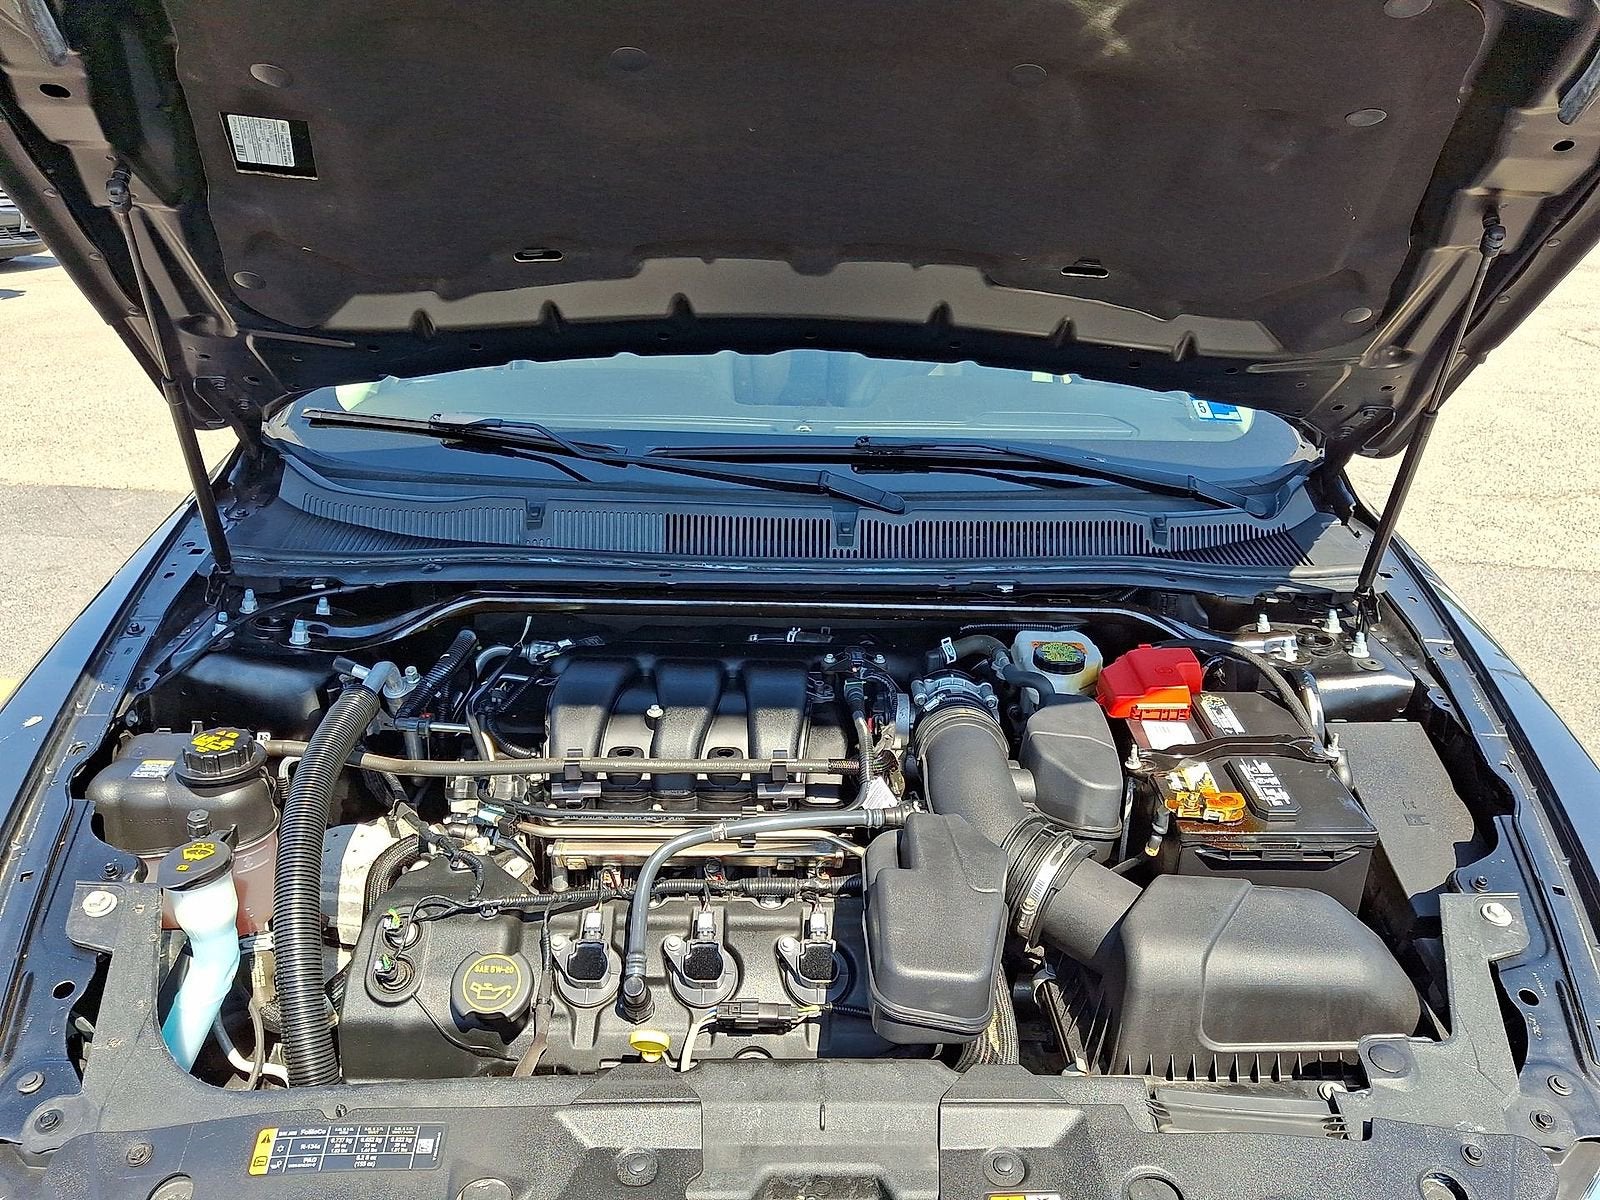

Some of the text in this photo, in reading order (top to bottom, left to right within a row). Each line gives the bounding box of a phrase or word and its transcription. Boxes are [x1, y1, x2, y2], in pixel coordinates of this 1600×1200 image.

[1197, 401, 1207, 414] 5
[474, 964, 515, 974] SAE 5W-20
[300, 1128, 327, 1136] FoMoCo
[300, 1142, 320, 1150] R-134a
